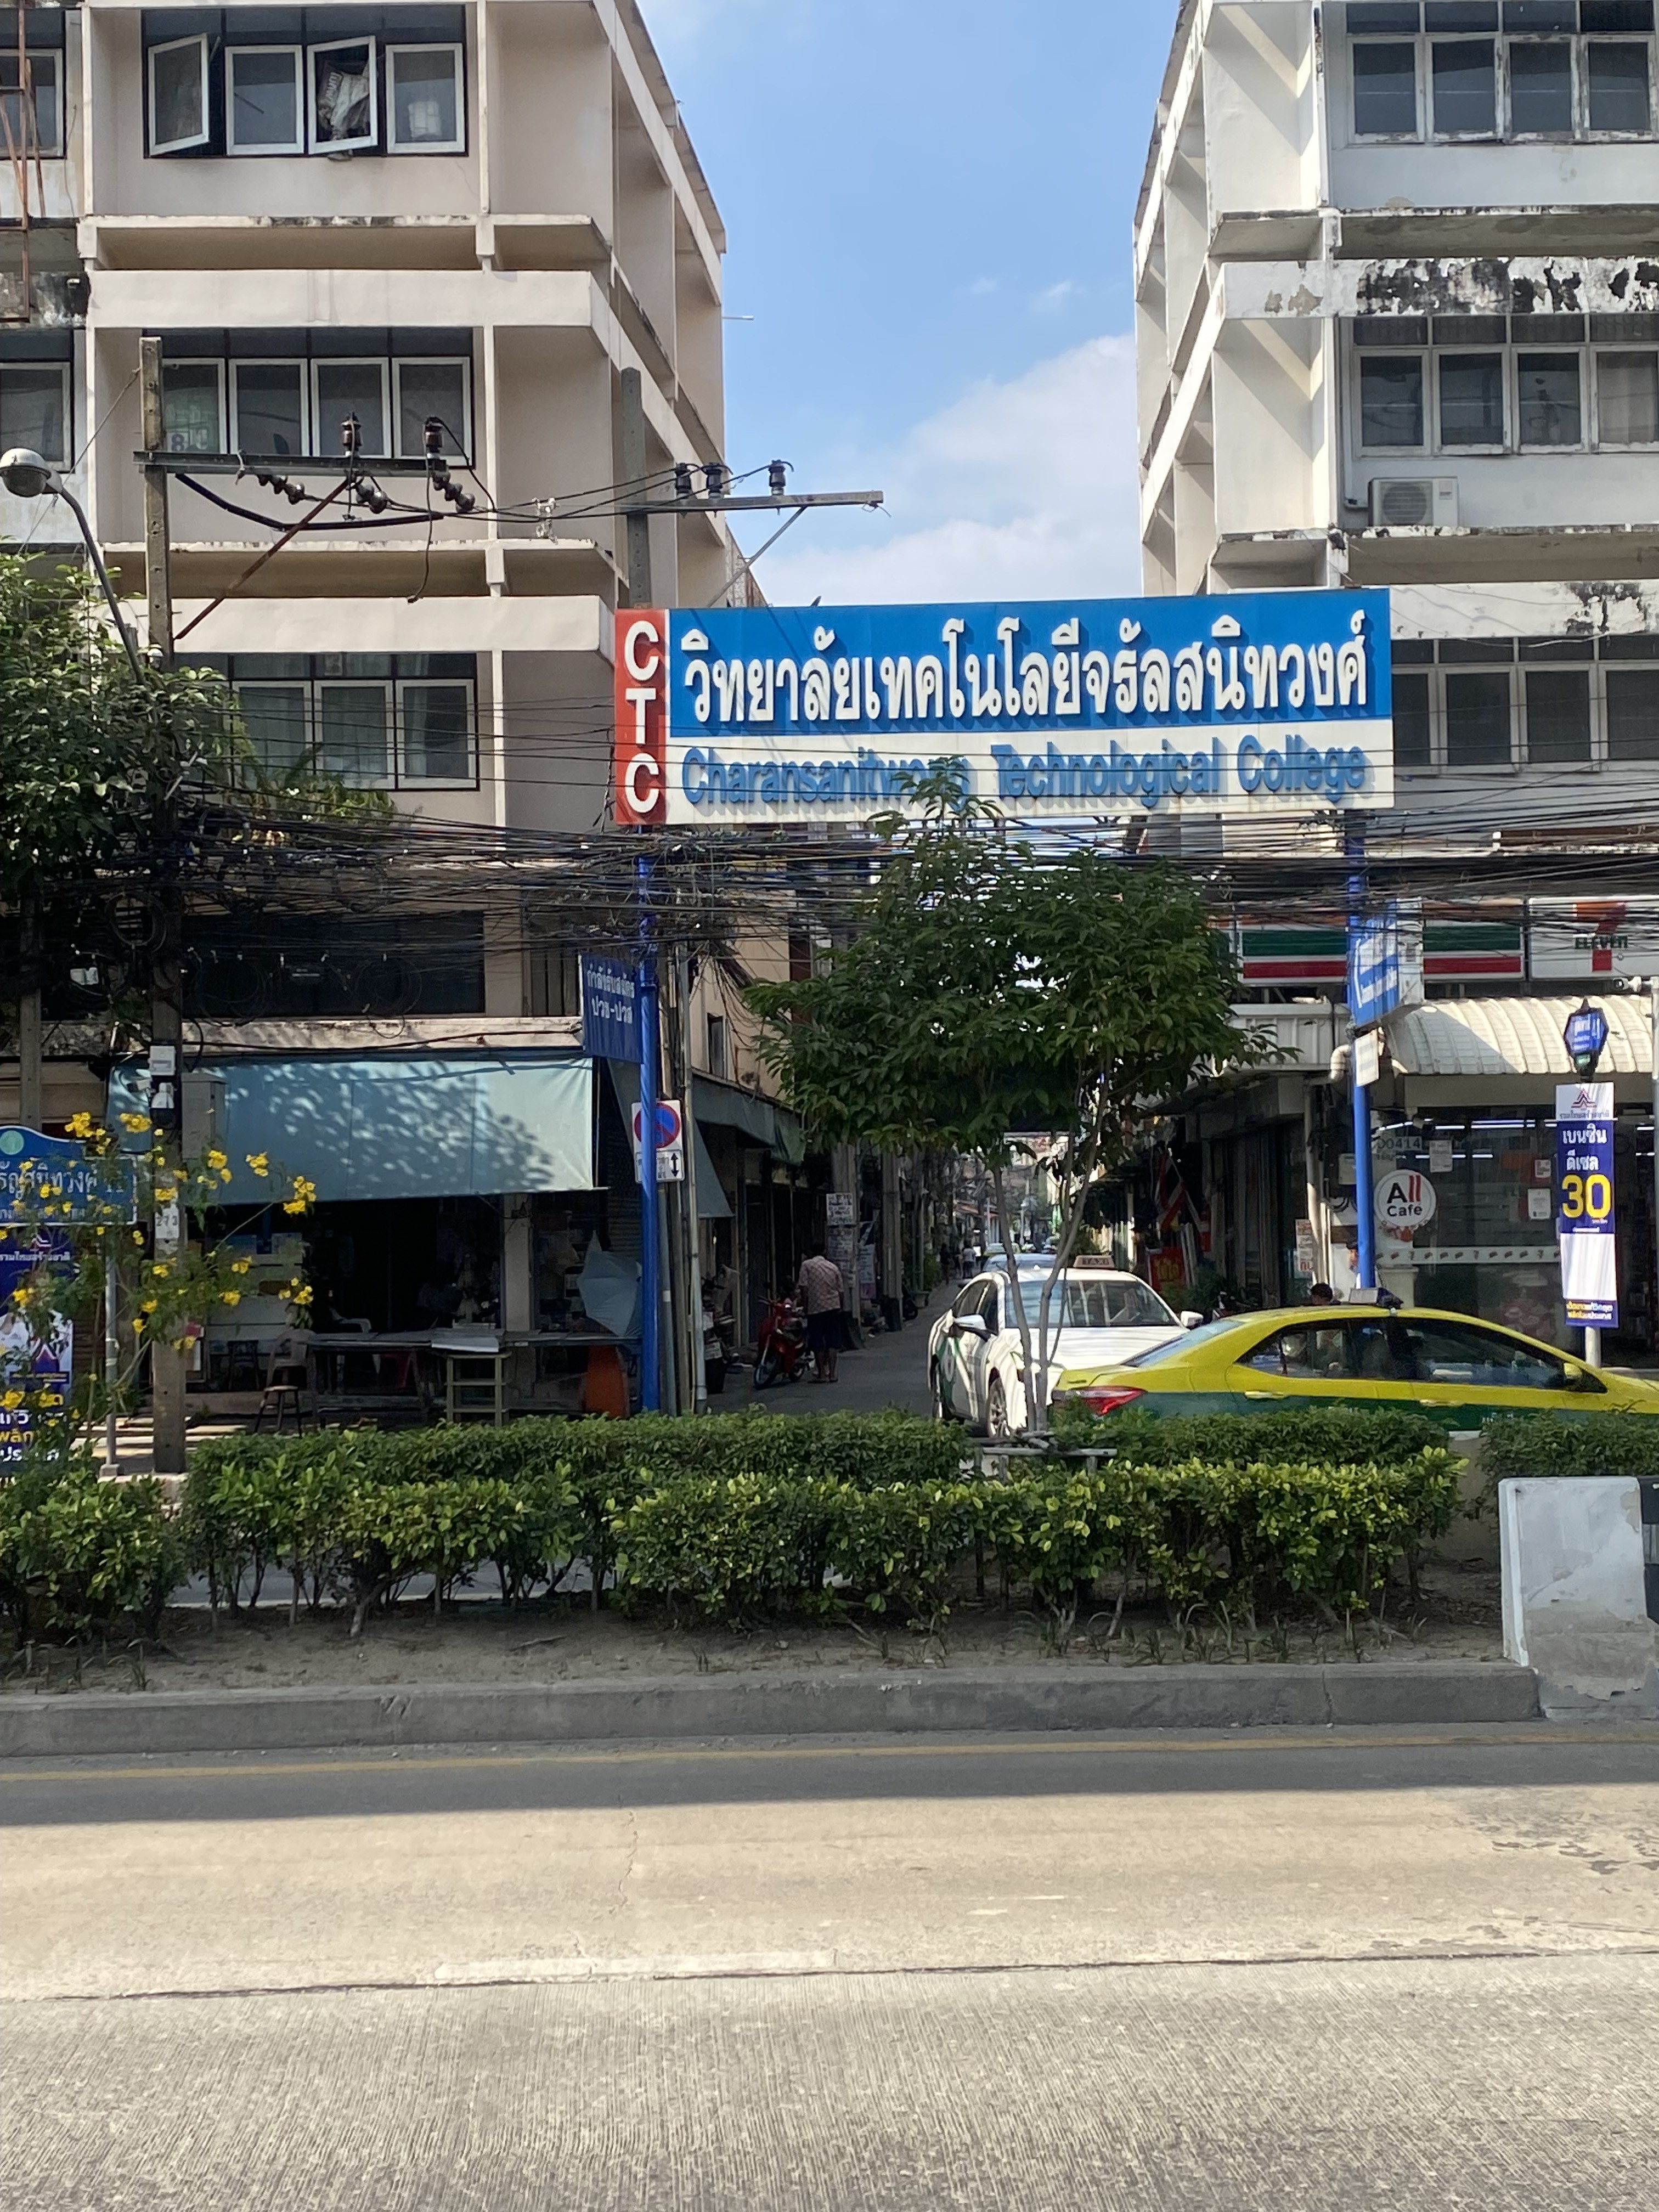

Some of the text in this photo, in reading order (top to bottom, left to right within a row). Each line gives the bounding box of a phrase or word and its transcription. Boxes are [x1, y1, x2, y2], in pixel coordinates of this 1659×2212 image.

[681, 610, 1366, 723] วิทยาลัยเทคโนโลยีจรัลสนิทวงศ์
[991, 737, 1219, 809] Technological
[1238, 735, 1365, 803] College
[1562, 1122, 1607, 1144] เบนซิน
[1566, 1149, 1599, 1171] ดีเซล
[1387, 1175, 1421, 1204] All
[1562, 1173, 1611, 1218] 30
